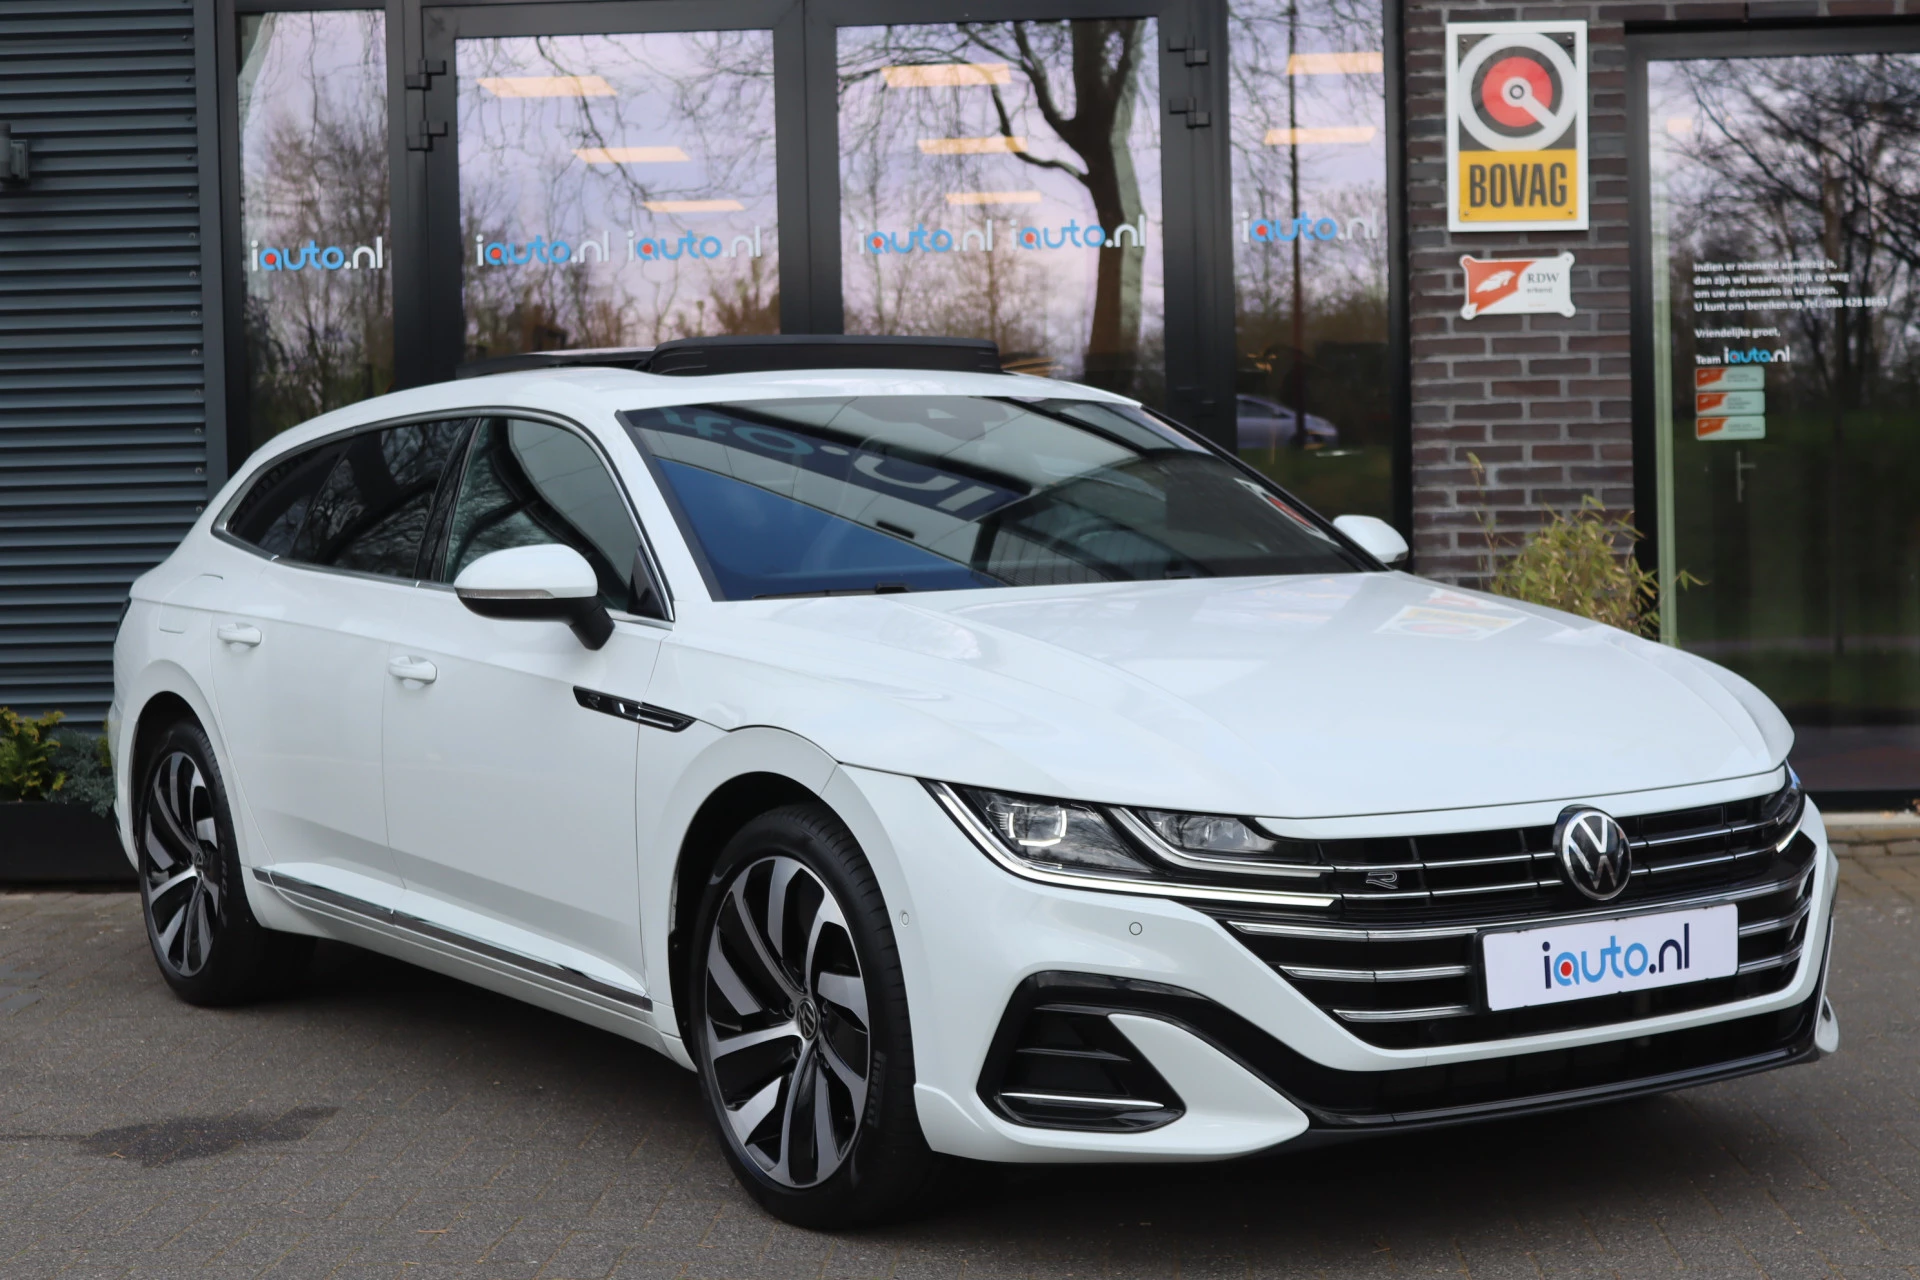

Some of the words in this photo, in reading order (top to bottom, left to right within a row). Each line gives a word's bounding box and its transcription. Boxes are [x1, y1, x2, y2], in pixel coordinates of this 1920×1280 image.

[1469, 162, 1567, 208] BOVAG
[626, 225, 762, 261] iauto.nl
[859, 219, 993, 255] iauto.nl
[1009, 214, 1146, 250] iauto.nl
[1241, 207, 1378, 243] iauto.nl
[250, 236, 383, 272] iauto.nl
[475, 230, 610, 266] iauto.nl
[1526, 273, 1560, 284] RDW
[1693, 262, 1724, 272] Indien
[1724, 262, 1736, 271] er
[1737, 261, 1780, 271] niemand
[1693, 276, 1713, 285] dan
[1731, 274, 1748, 286] wij
[1814, 274, 1828, 283] op
[1829, 273, 1850, 283] weg
[1693, 289, 1711, 298] om
[1711, 289, 1728, 298] uw
[1728, 287, 1782, 297] droomauto
[1783, 286, 1793, 295] in
[1794, 286, 1805, 295] te
[1805, 285, 1839, 296] kopen.
[1694, 303, 1703, 312] U
[1703, 301, 1727, 311] kunt
[1727, 302, 1746, 311] ons
[1789, 300, 1803, 311] op
[1694, 327, 1752, 339] Vriendelijke
[1695, 354, 1722, 364] Team
[1724, 345, 1791, 364] iauto.nl
[1541, 922, 1690, 989] iauto.nl
